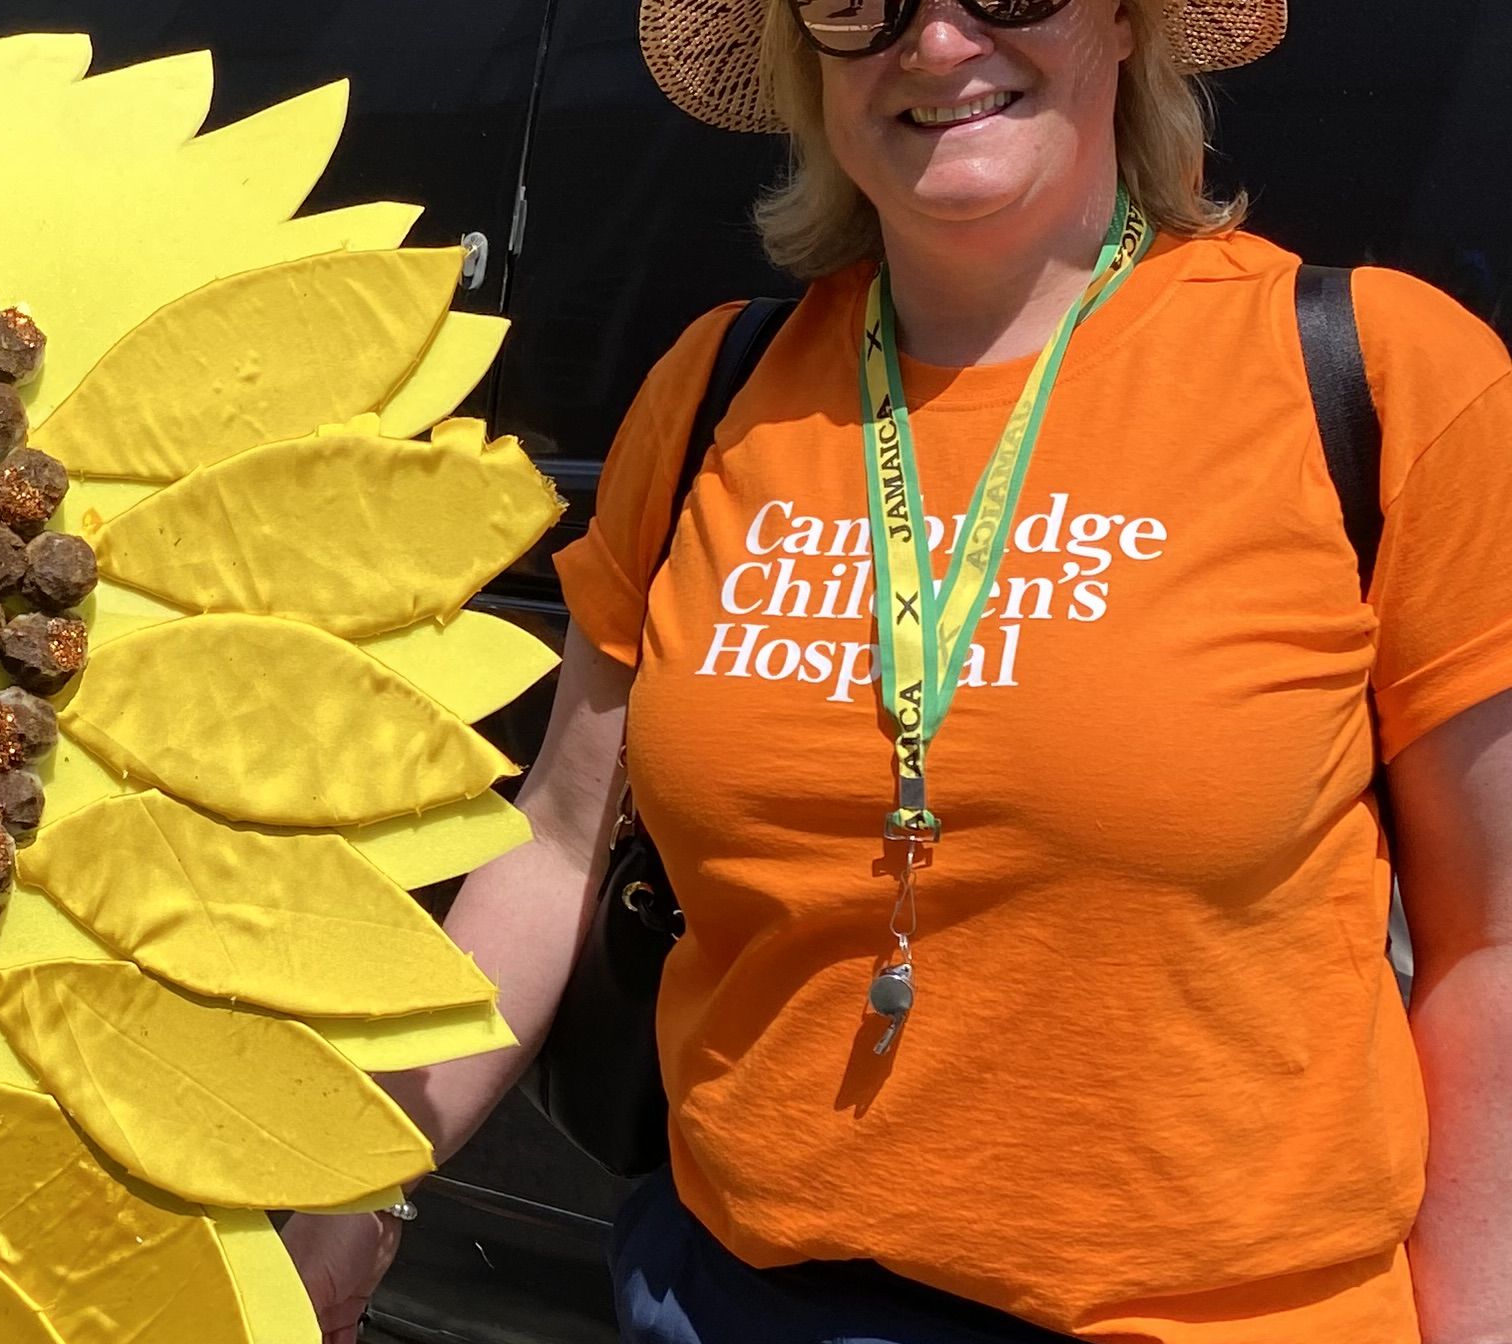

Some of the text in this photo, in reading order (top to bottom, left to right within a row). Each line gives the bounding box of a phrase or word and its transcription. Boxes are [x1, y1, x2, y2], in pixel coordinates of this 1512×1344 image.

[876, 394, 912, 543] JAMAICA
[745, 493, 1168, 576] Camdge
[721, 558, 1109, 622] Chiln's
[694, 623, 1020, 703] Hospal
